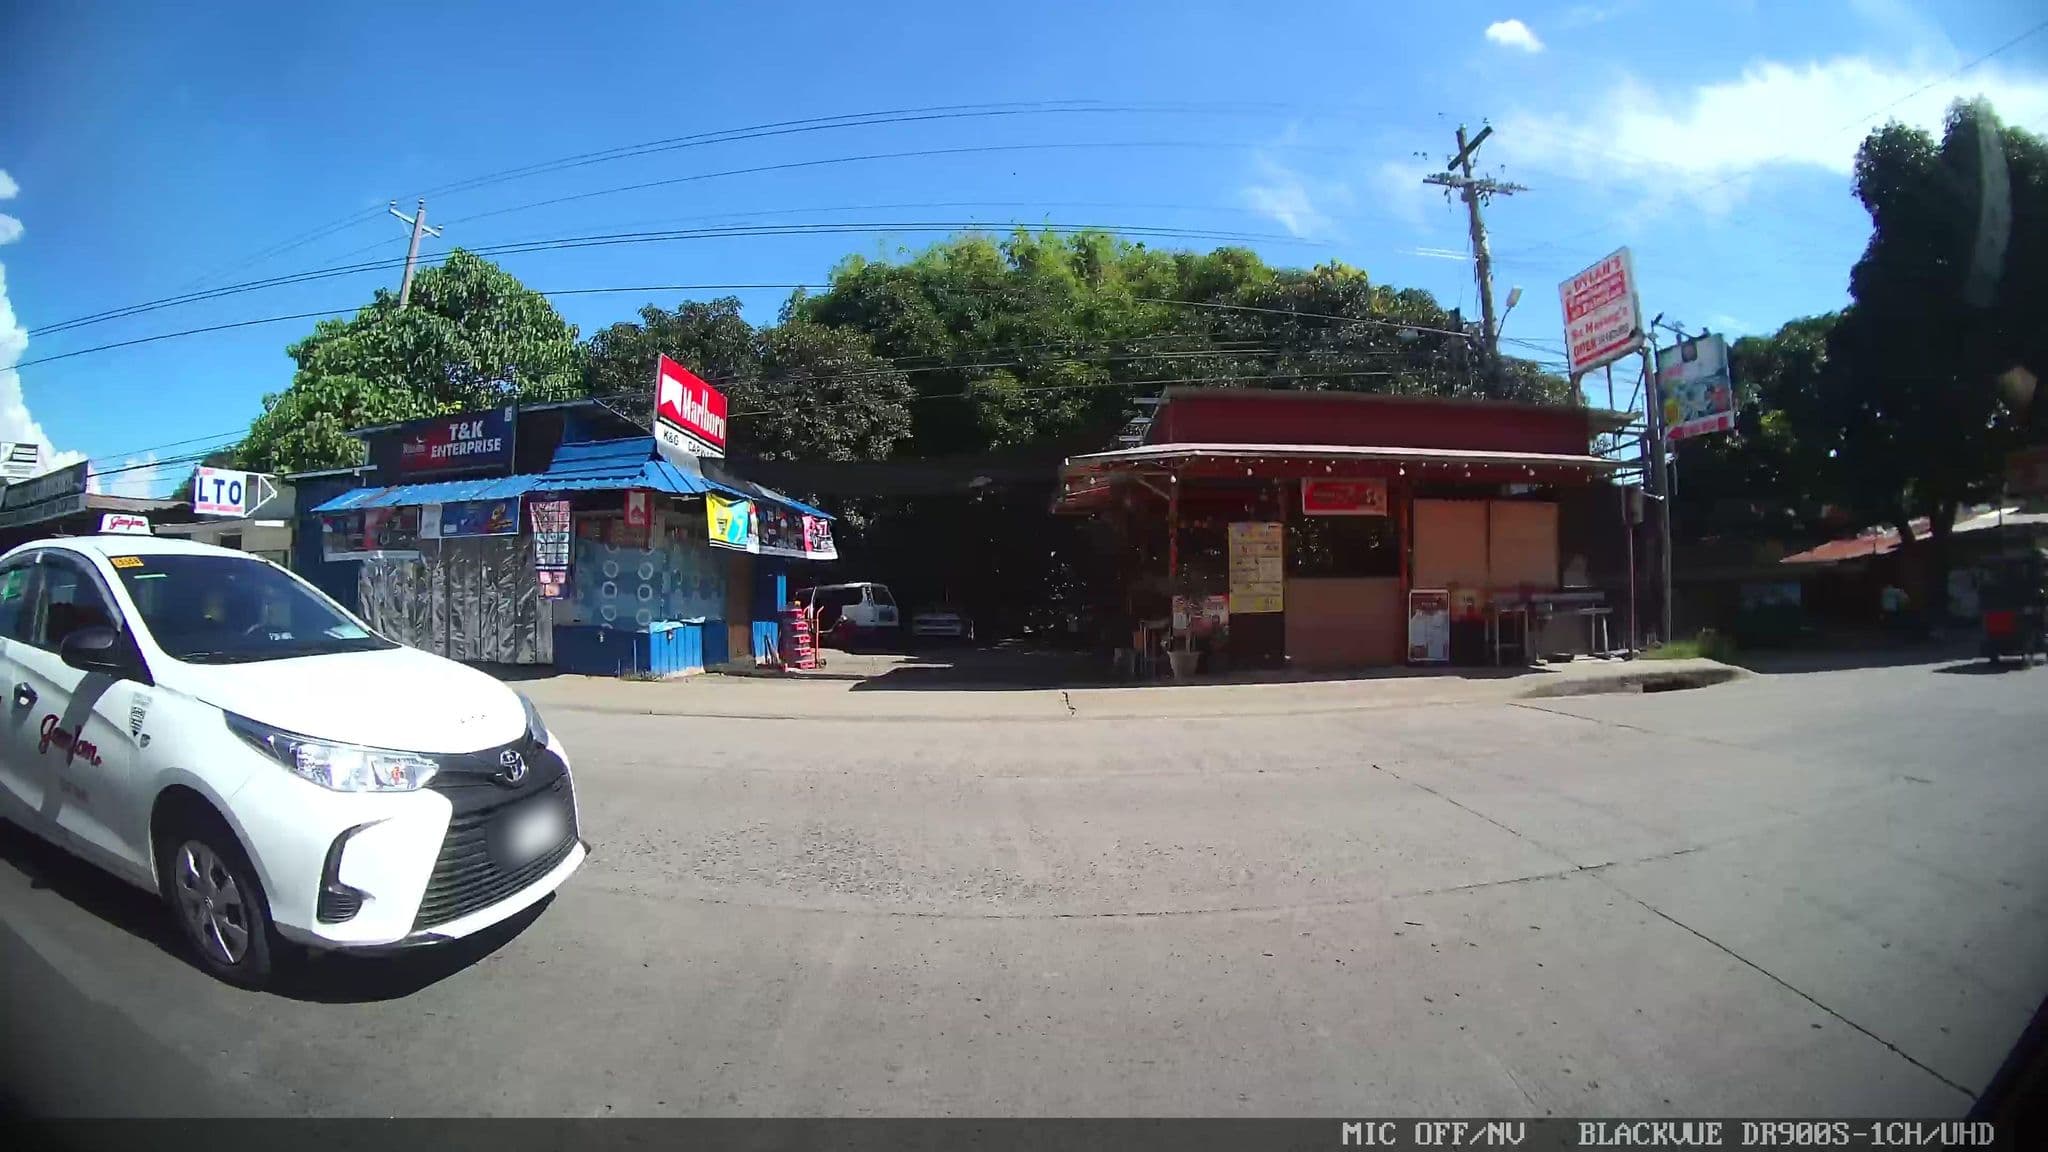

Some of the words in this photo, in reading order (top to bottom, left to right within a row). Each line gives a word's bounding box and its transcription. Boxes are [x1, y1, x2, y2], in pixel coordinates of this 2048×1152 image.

[681, 386, 724, 440] Marlboro
[448, 420, 484, 441] T&K
[431, 438, 502, 458] ENTERPRISE
[198, 477, 242, 505] LTO
